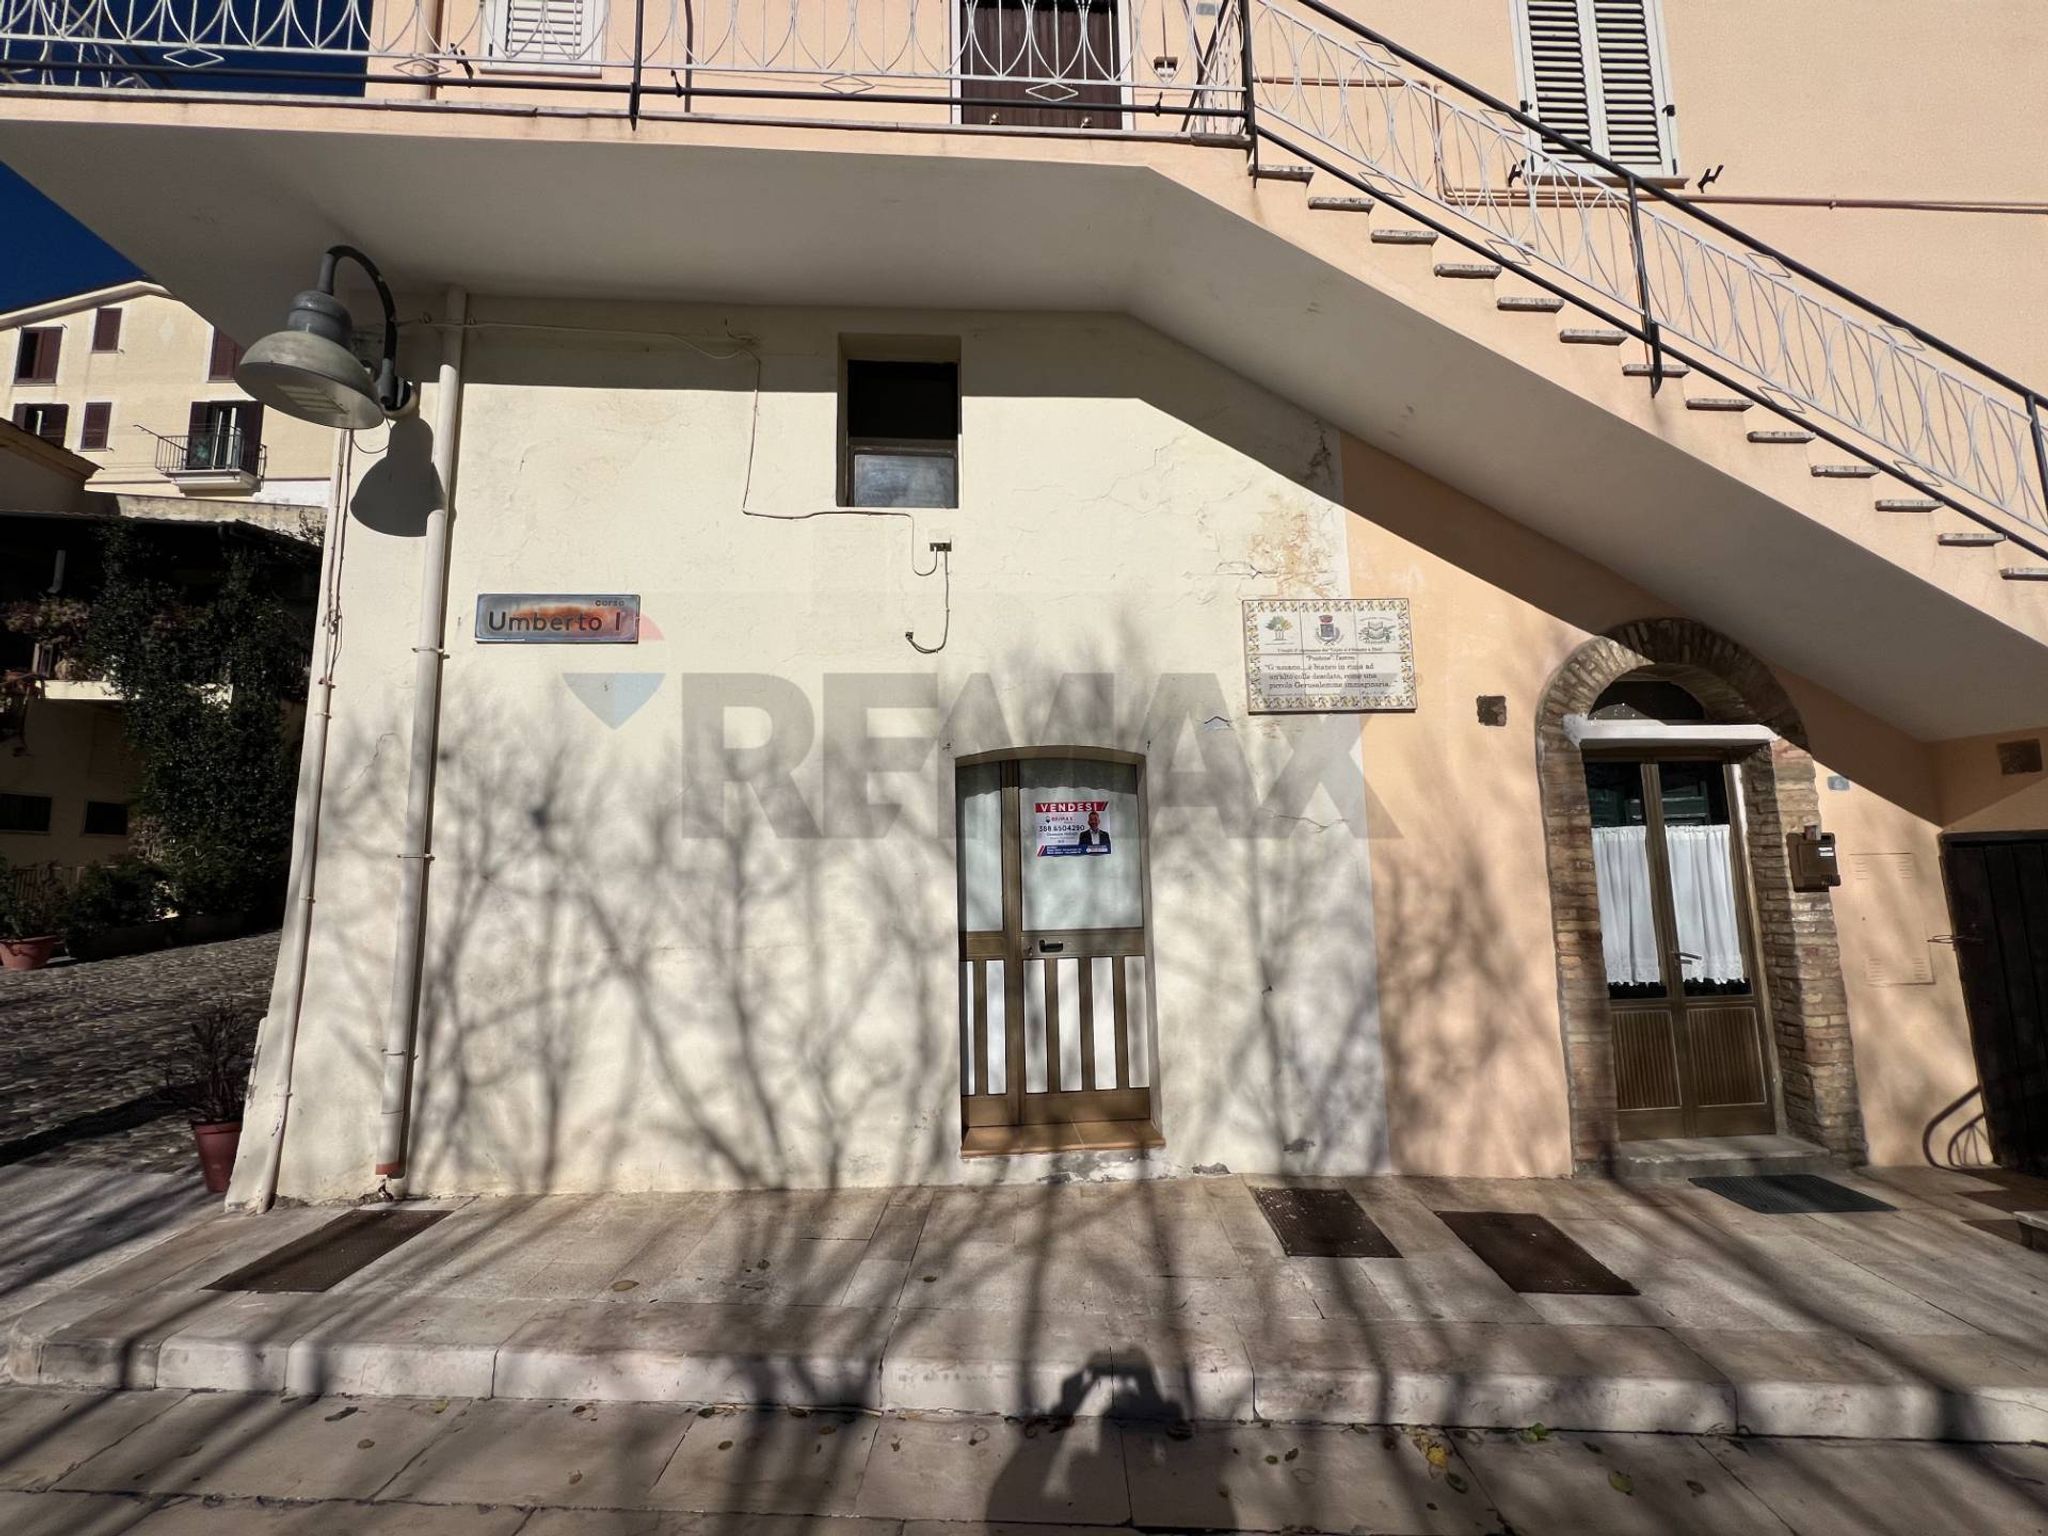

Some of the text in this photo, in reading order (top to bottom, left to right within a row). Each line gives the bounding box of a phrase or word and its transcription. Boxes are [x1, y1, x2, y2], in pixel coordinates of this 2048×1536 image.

[488, 611, 621, 632] Umberto I
[1040, 802, 1097, 812] VENDESI
